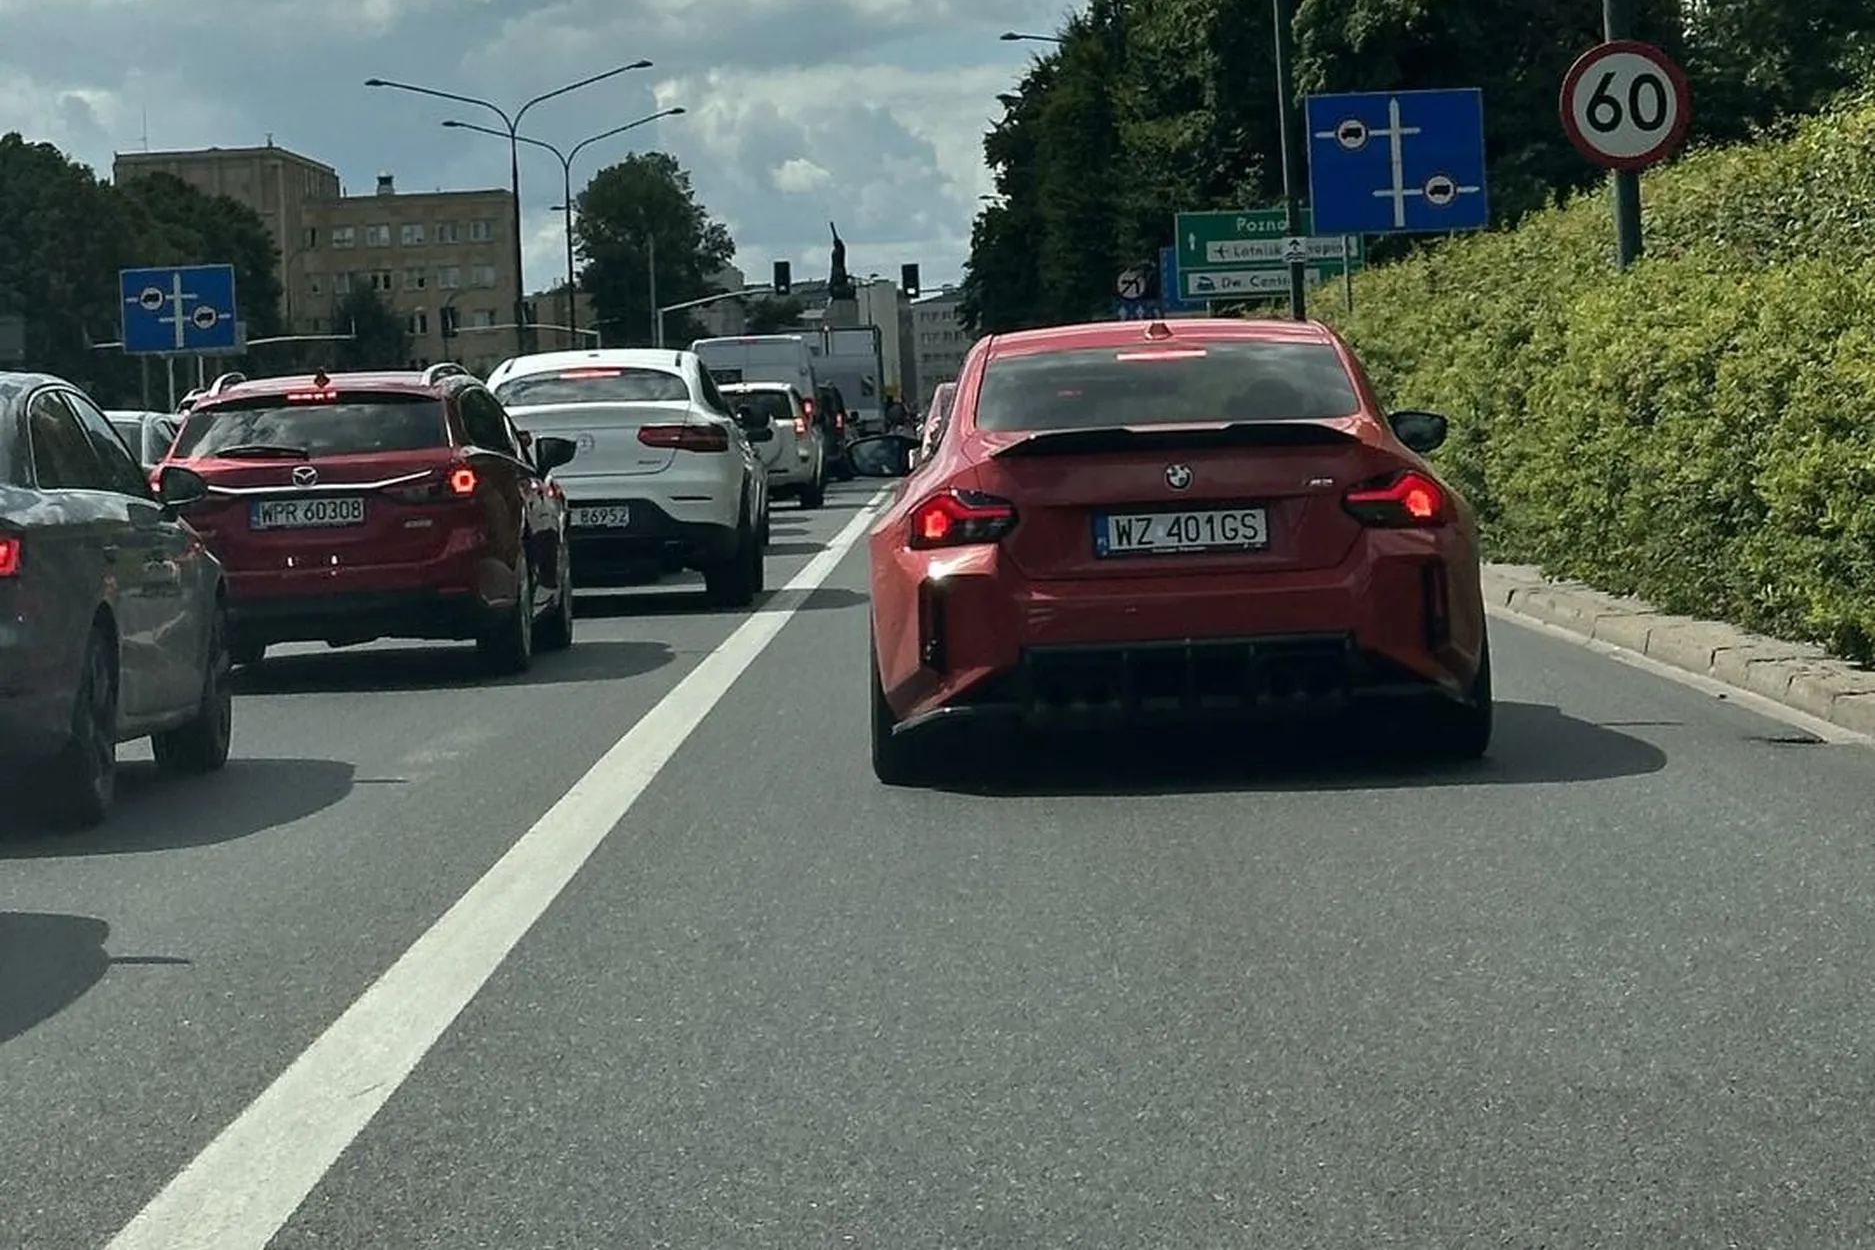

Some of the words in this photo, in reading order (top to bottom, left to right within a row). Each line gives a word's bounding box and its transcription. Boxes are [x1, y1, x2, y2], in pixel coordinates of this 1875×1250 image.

[1585, 70, 1667, 133] 60
[1236, 216, 1289, 231] Pozna
[1233, 244, 1283, 259] Lotnisk
[262, 503, 299, 523] WPR
[303, 500, 362, 521] 60308
[1114, 516, 1153, 546] WZ
[1165, 512, 1258, 543] 401GS
